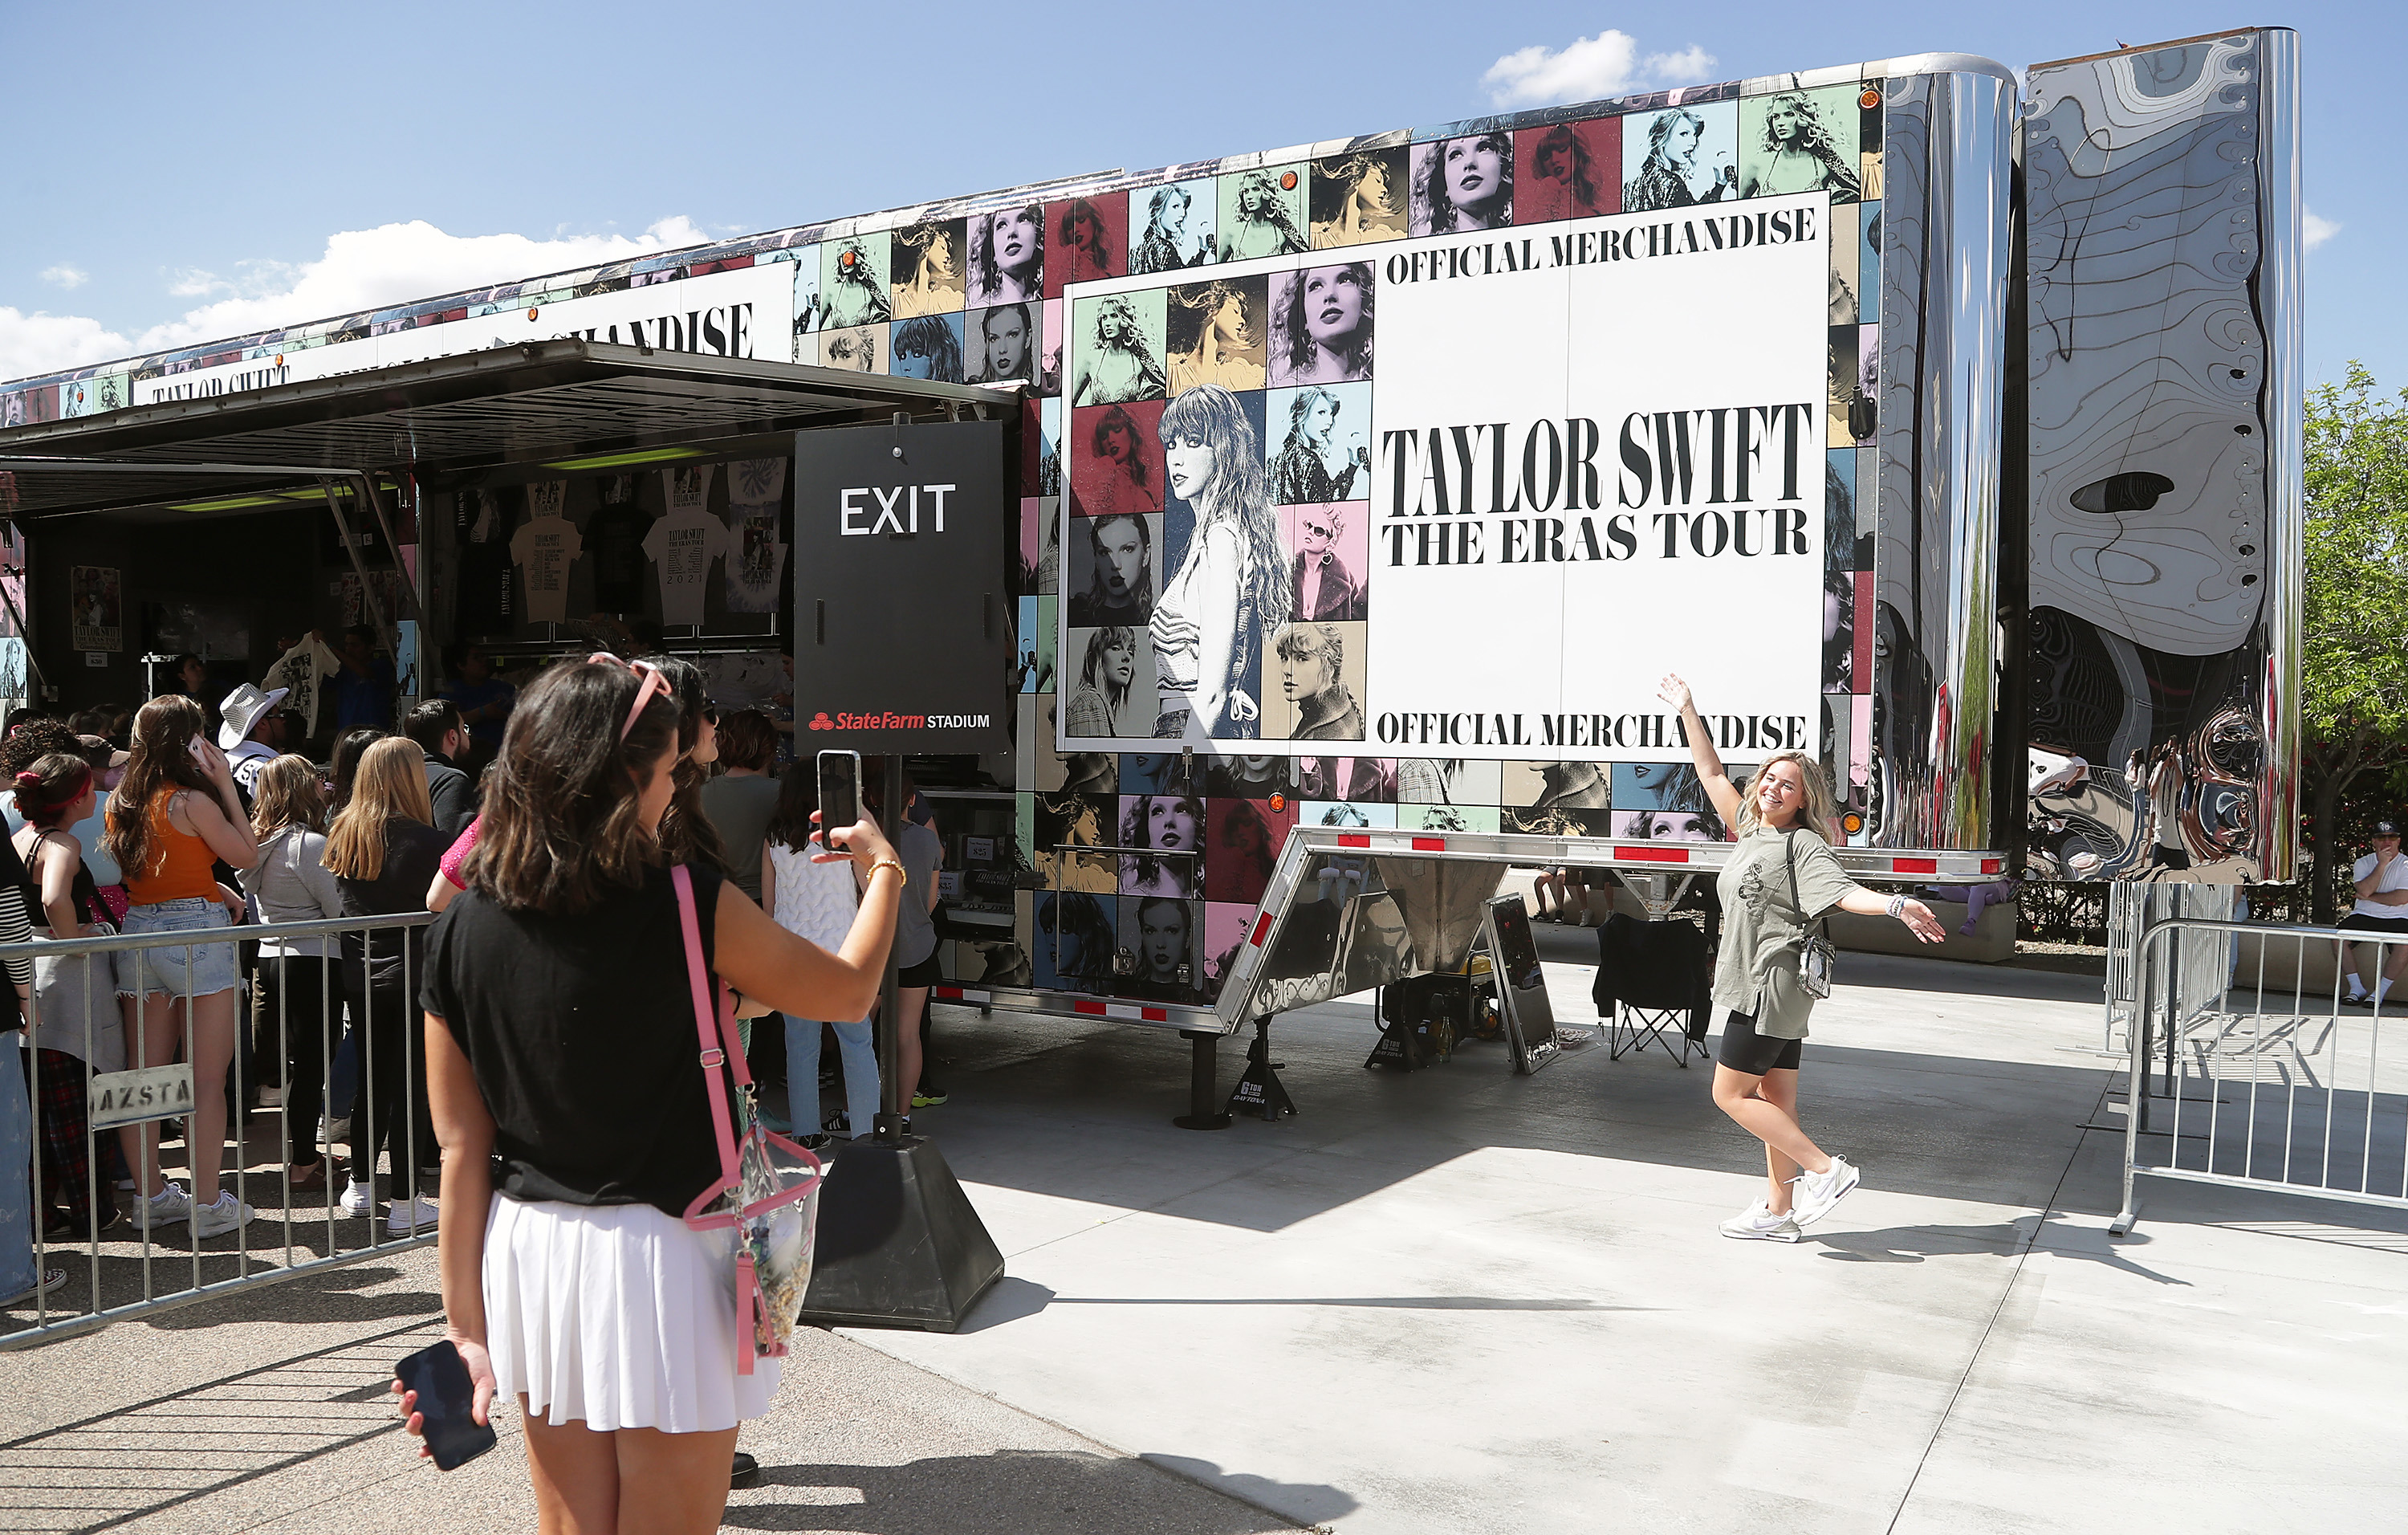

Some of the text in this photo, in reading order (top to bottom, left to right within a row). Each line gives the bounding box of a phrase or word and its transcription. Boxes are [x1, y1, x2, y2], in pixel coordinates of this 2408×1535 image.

[1387, 208, 1816, 285] OFFICIAL MERCHANDISE
[374, 382, 737, 425] SWIFT
[1383, 403, 1813, 518] TAYLOR SWIFT
[840, 483, 956, 536] EXIT
[1382, 508, 1812, 568] THE ERAS TOUR
[927, 715, 990, 728] STADIUM
[1377, 711, 1808, 750] OFFICIAL MERCHANDISE
[1376, 1050, 1403, 1058] DAYTONA
[1382, 1038, 1389, 1050] 6
[100, 1080, 190, 1110] AZSTA
[1233, 1094, 1266, 1104] DAYTONA
[1241, 1081, 1250, 1095] 6
[1250, 1084, 1263, 1093] TON
